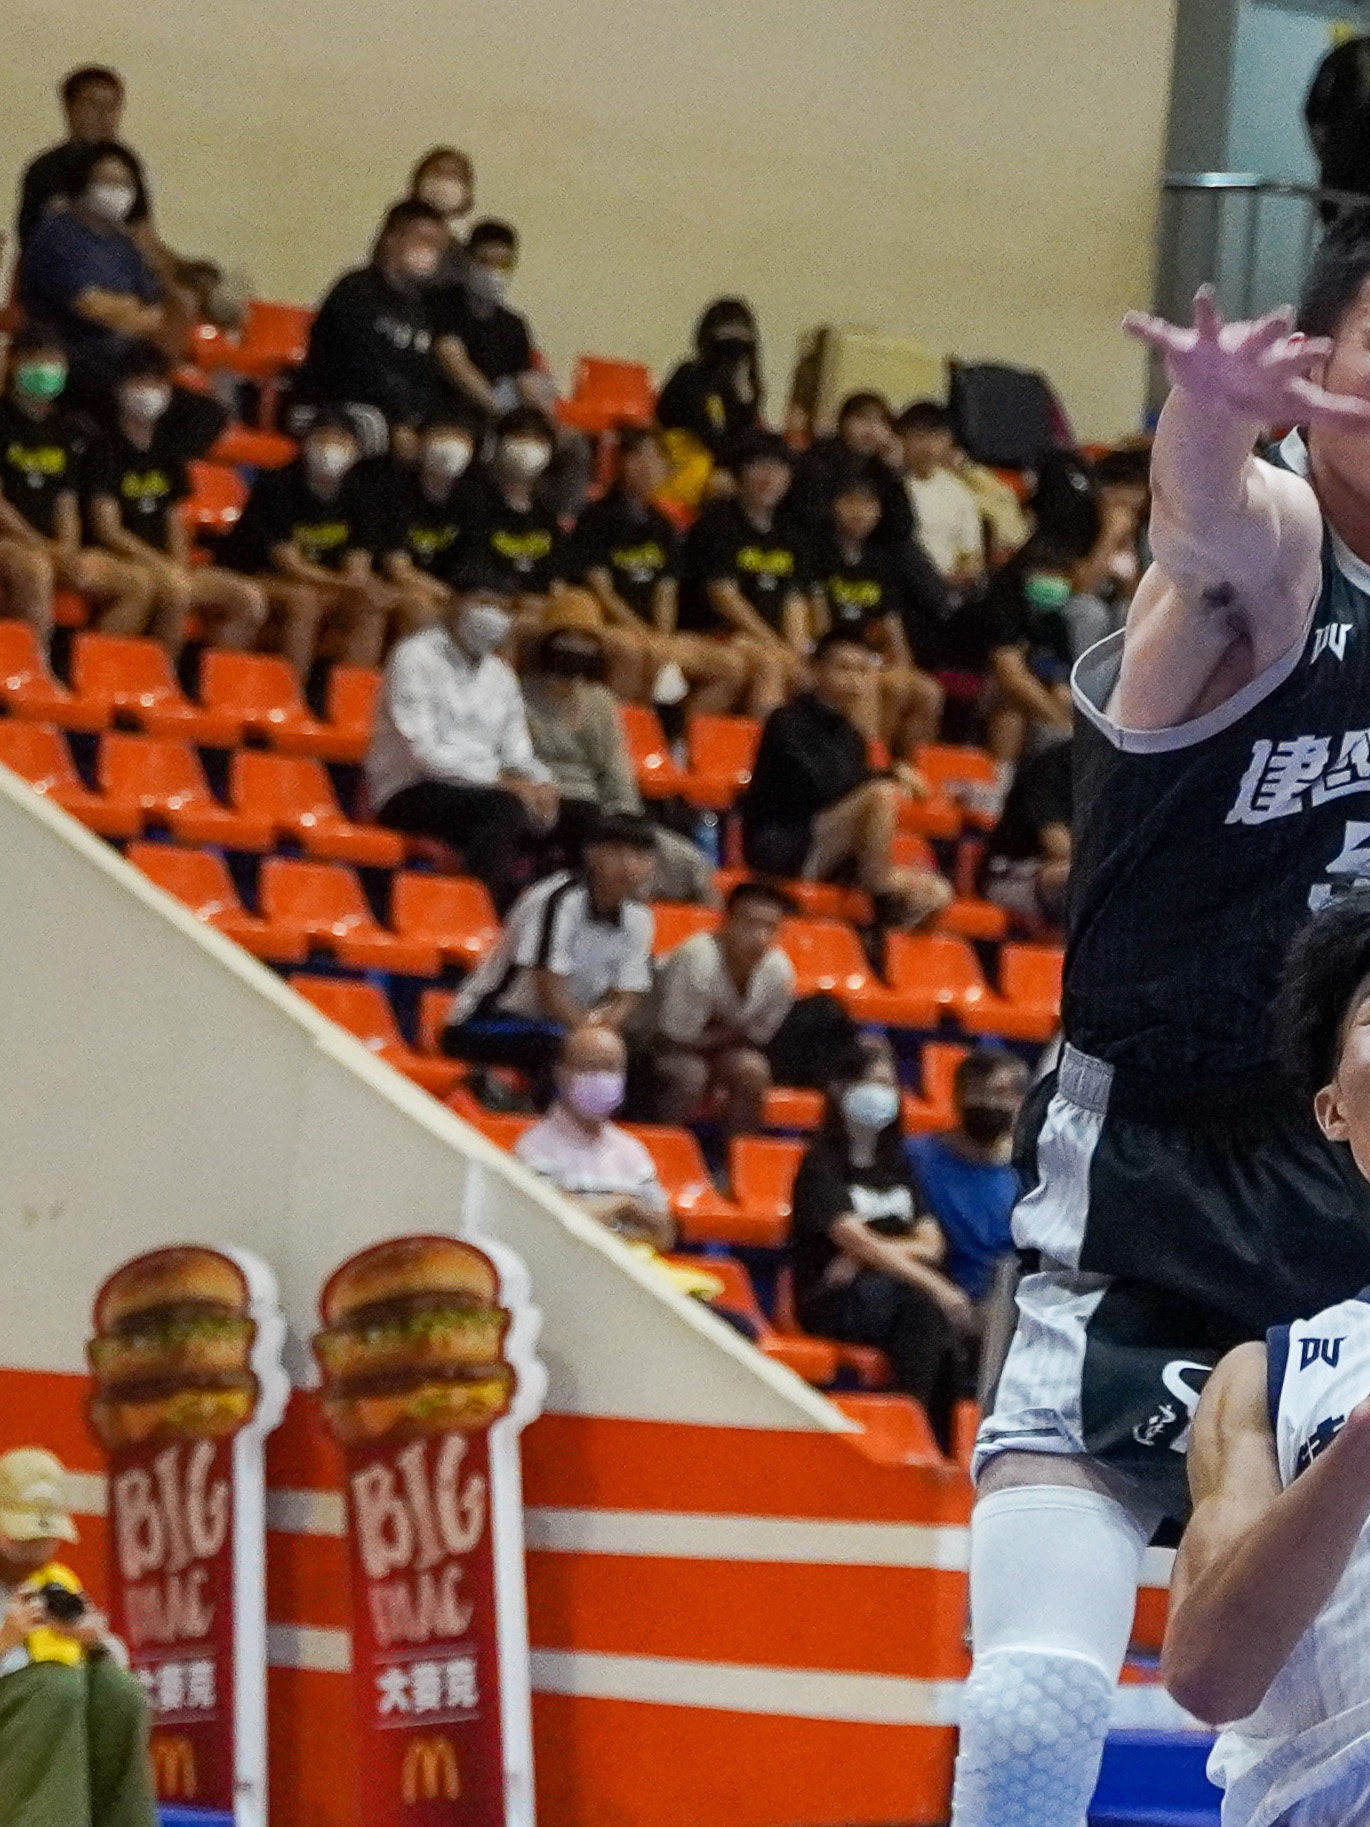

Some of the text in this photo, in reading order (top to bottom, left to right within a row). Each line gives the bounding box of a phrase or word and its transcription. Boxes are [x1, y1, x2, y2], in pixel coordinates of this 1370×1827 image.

[114, 1439, 230, 1582] BIG
[352, 1432, 486, 1580] BIG
[375, 1656, 480, 1714] 大麥克
